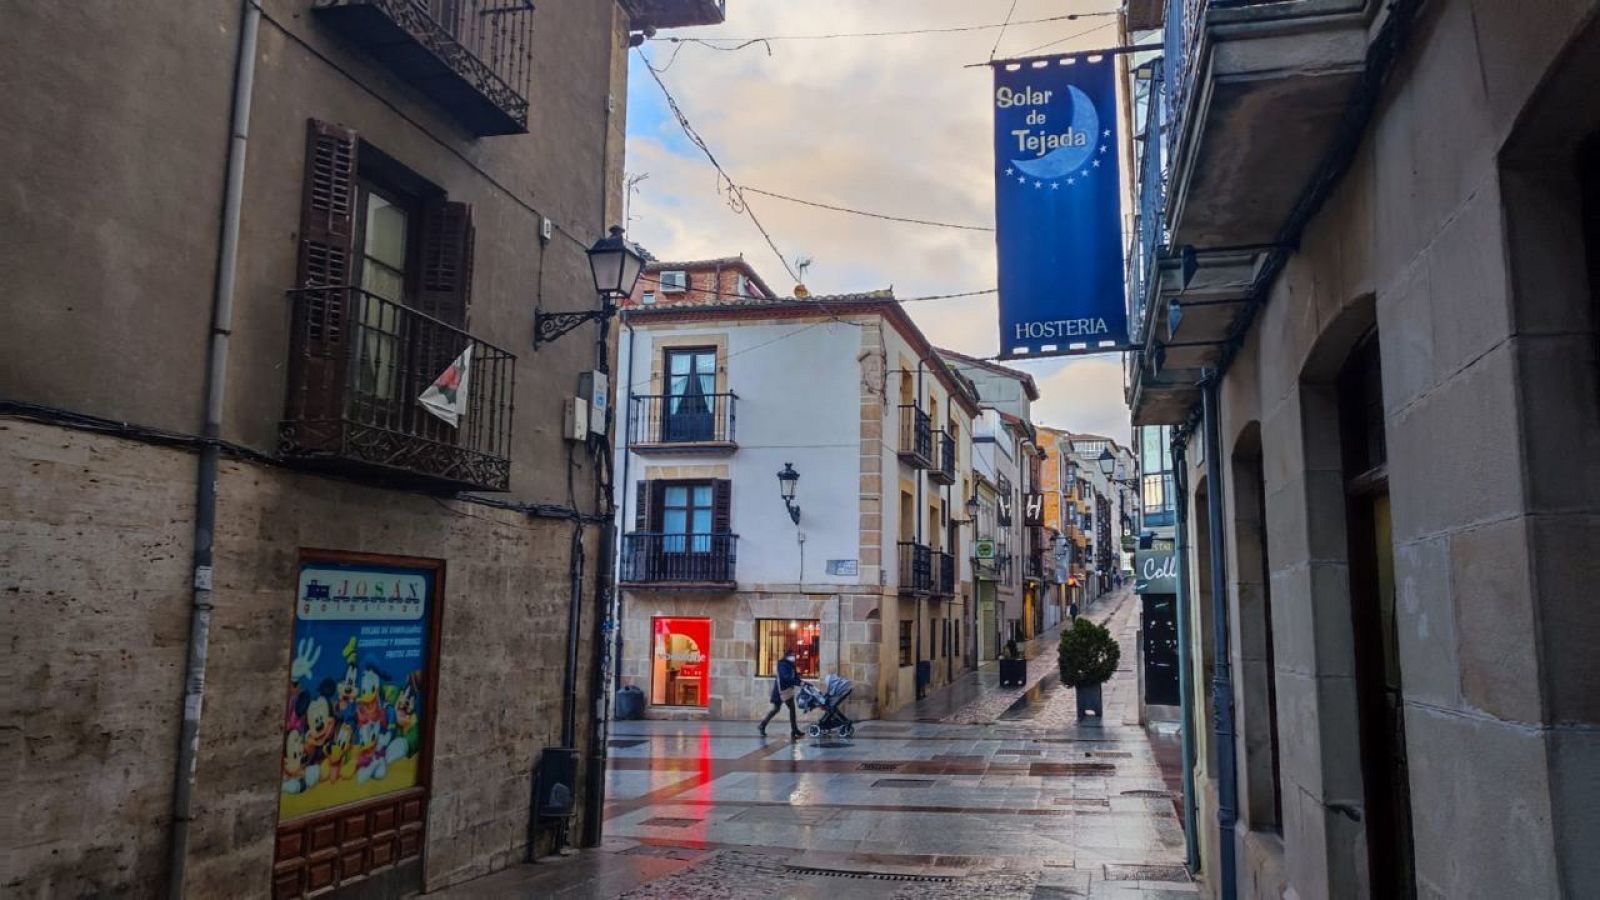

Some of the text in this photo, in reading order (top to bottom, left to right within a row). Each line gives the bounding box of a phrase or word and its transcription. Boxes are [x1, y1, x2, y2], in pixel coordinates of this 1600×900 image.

[996, 85, 1053, 108] Solar
[1025, 109, 1046, 125] de
[1011, 126, 1087, 156] Tejada
[1015, 317, 1109, 340] HOSTERIA
[1026, 494, 1042, 520] H
